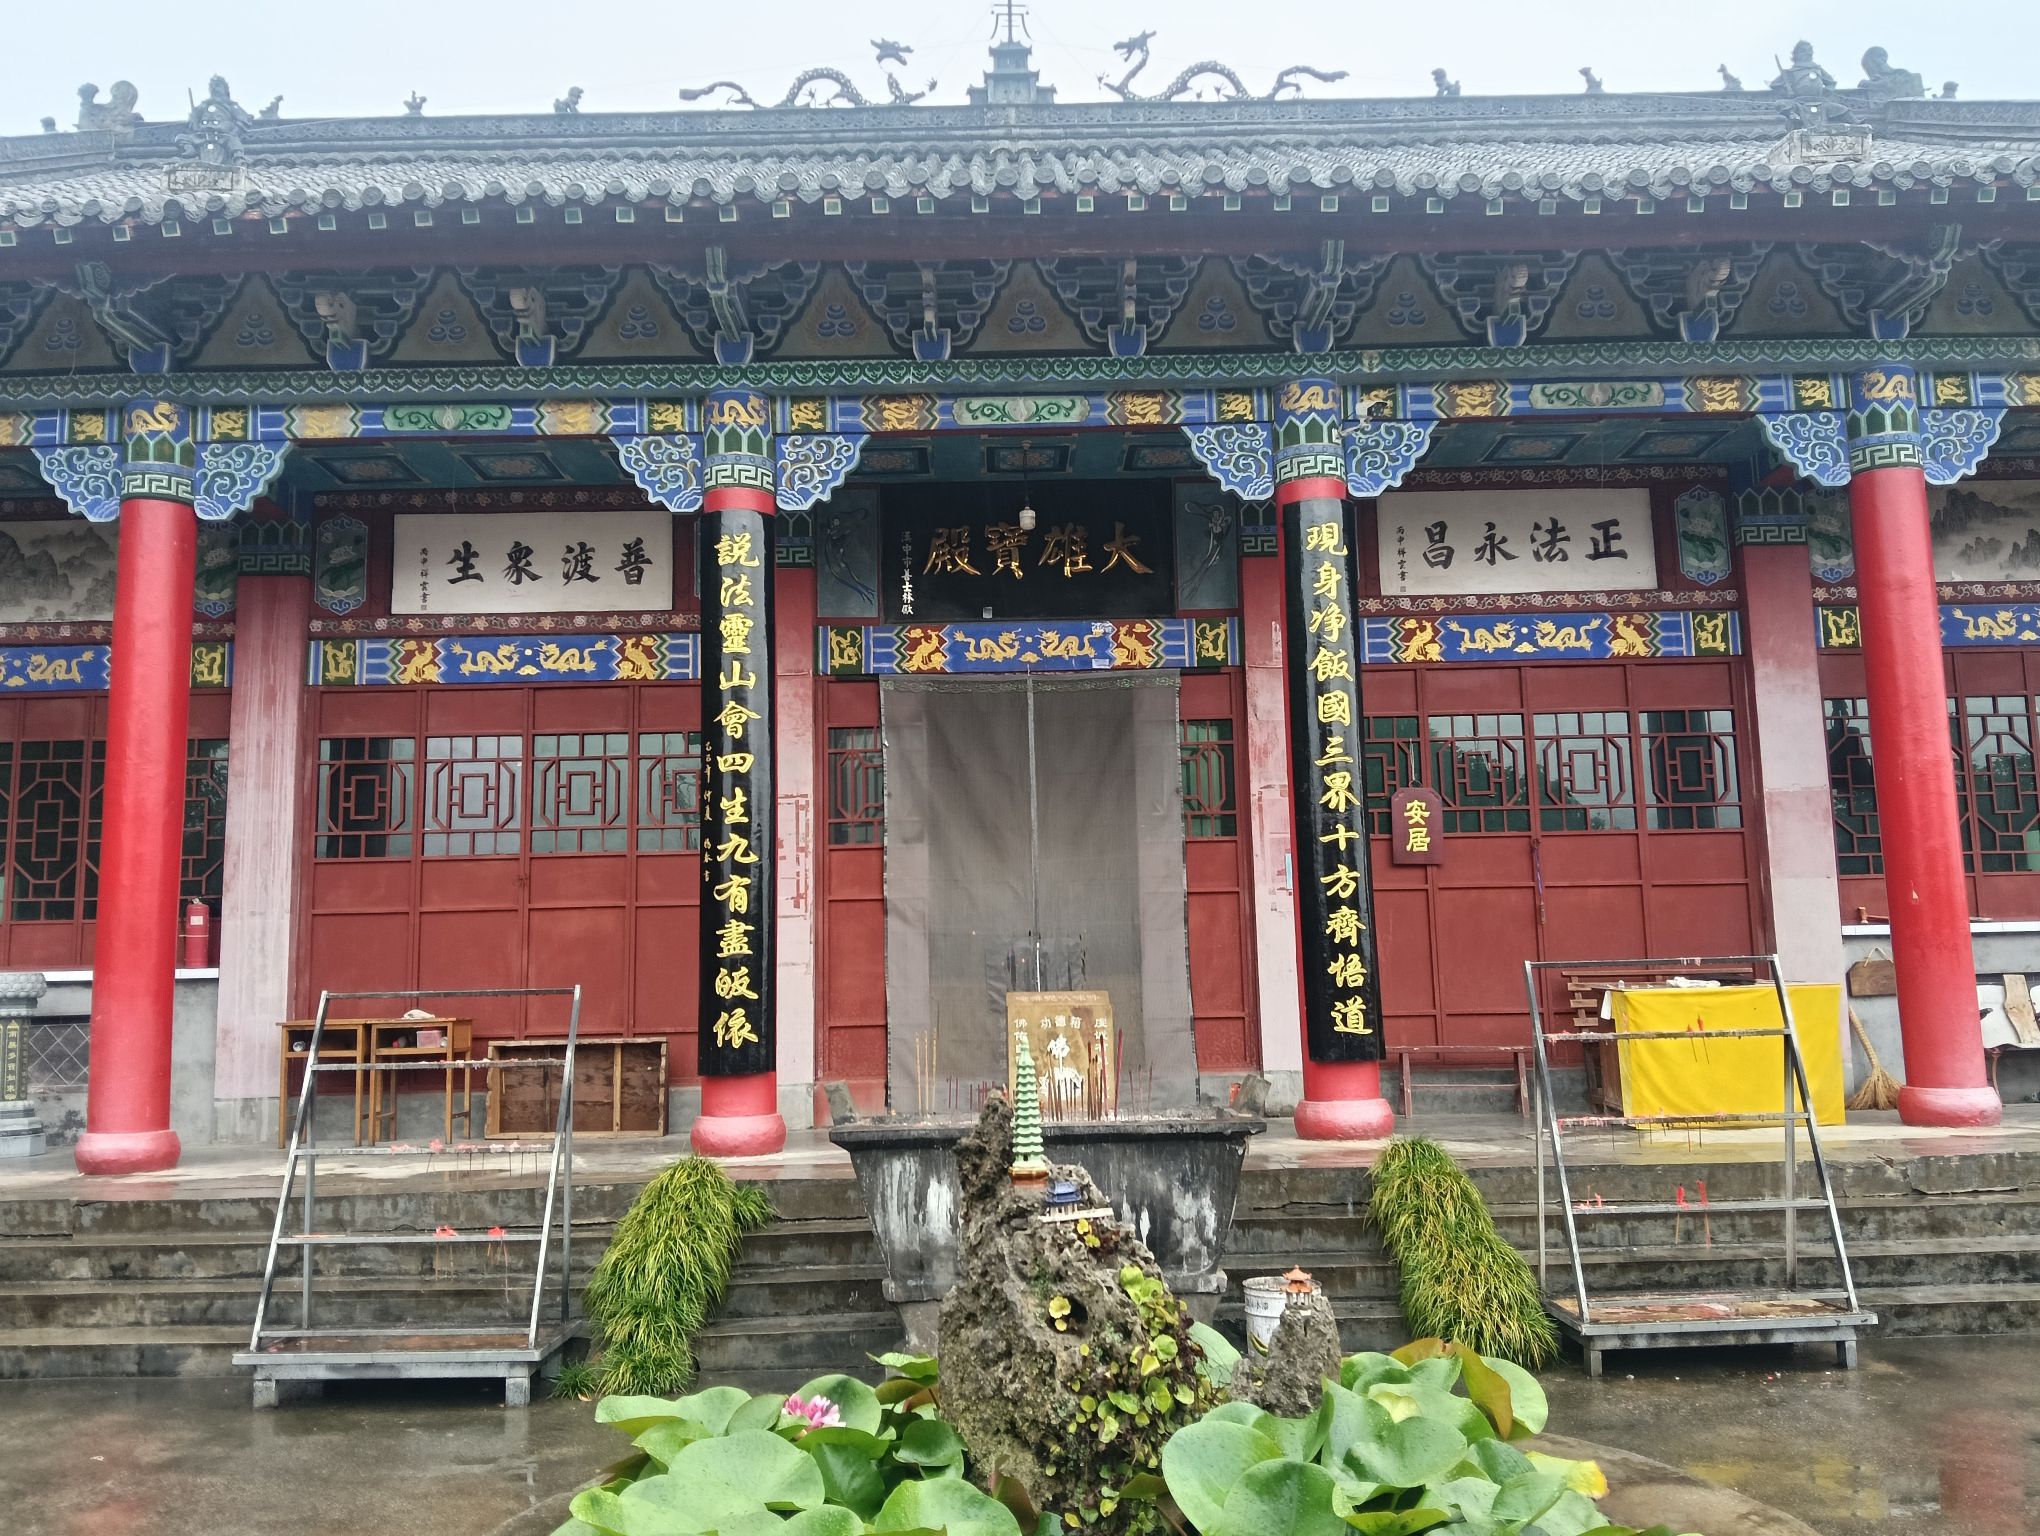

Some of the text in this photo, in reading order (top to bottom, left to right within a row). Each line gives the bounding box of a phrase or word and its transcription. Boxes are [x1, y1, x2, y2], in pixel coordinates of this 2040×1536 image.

[923, 521, 1154, 579] 大雄寶殿
[1421, 516, 1629, 570] 正法永昌
[1403, 799, 1431, 852] 安居
